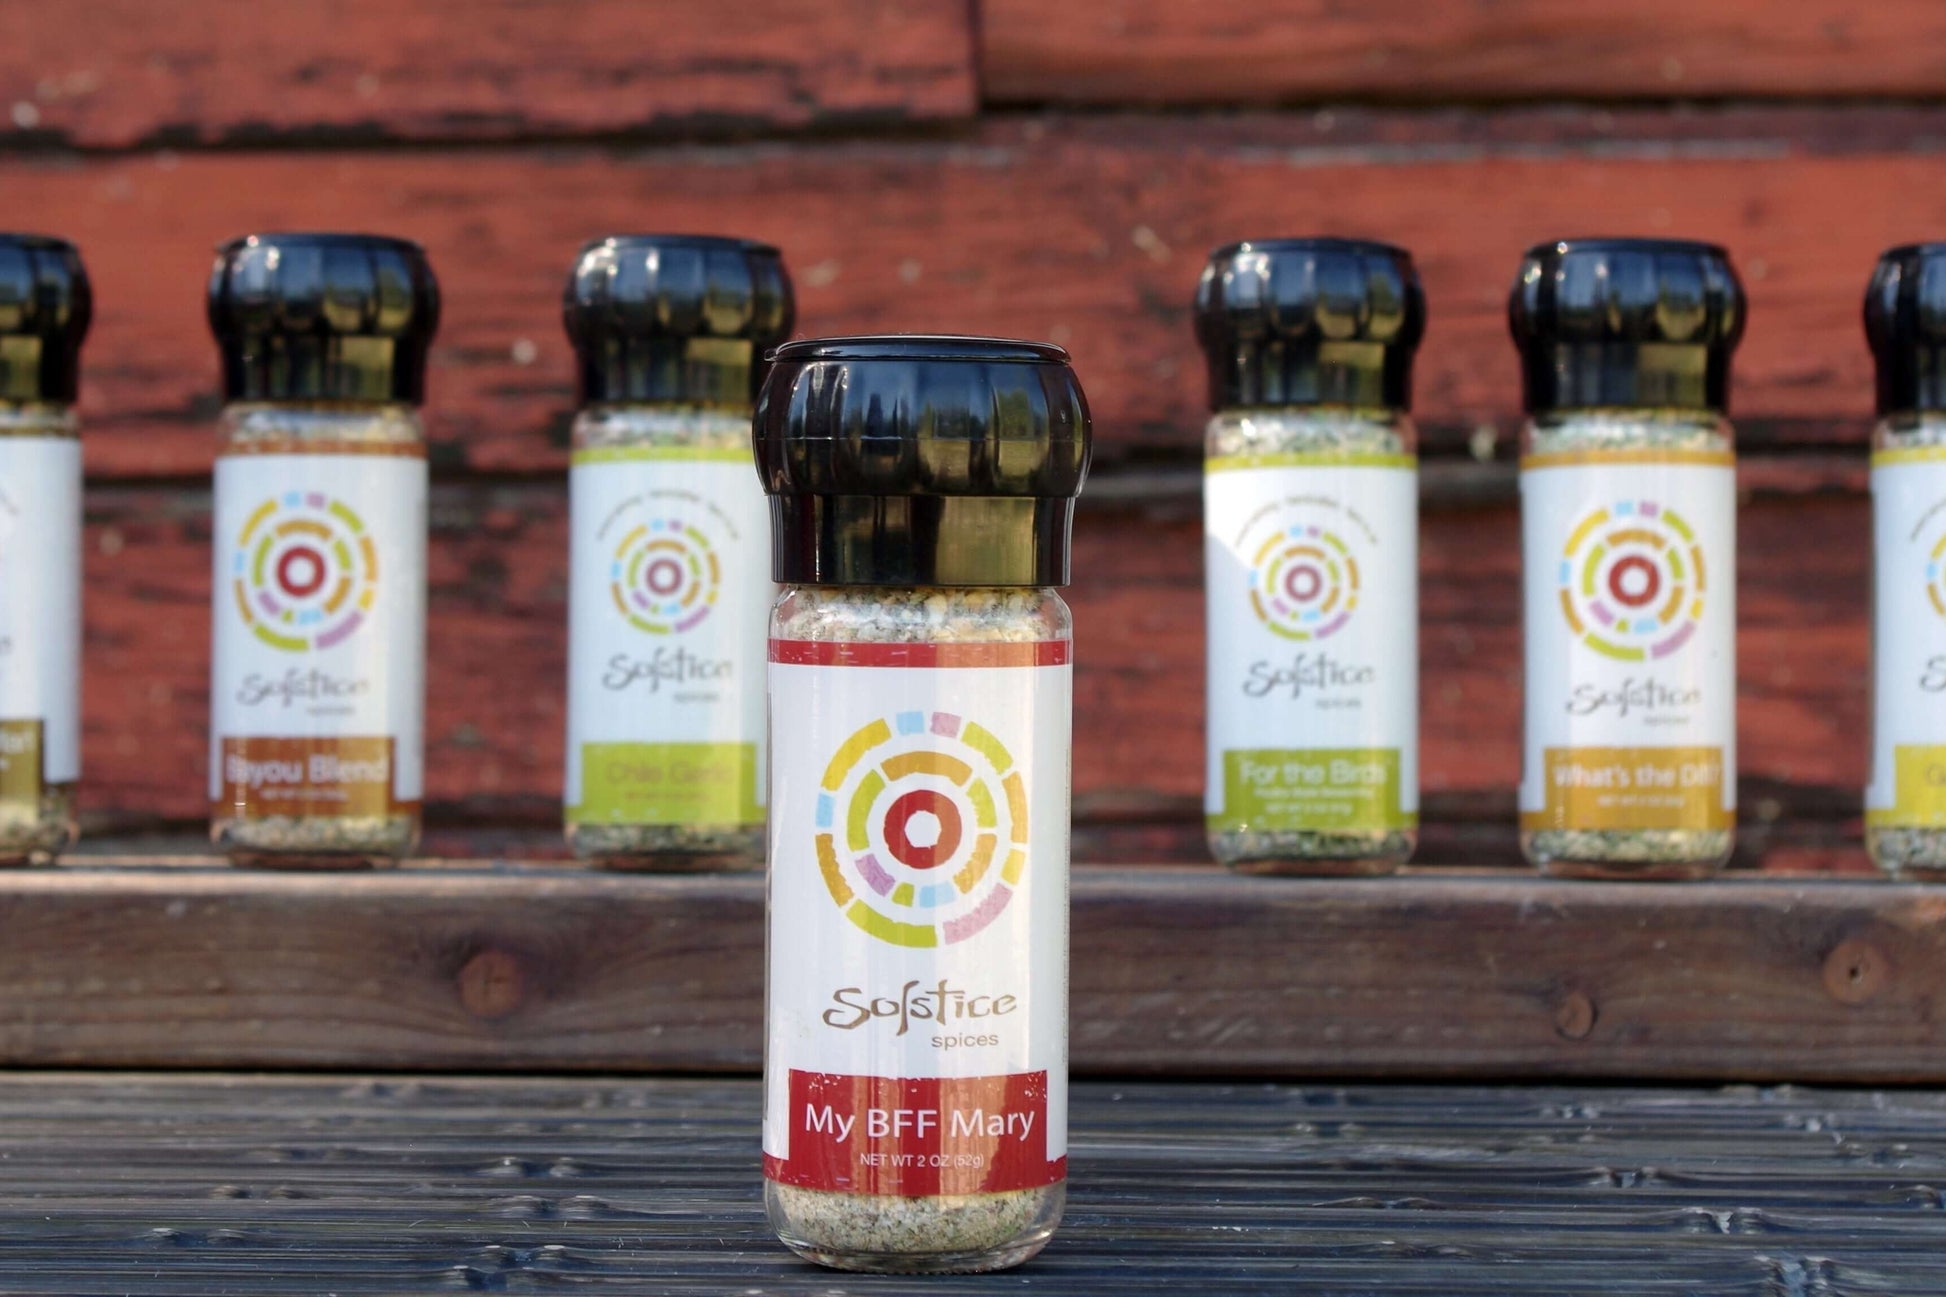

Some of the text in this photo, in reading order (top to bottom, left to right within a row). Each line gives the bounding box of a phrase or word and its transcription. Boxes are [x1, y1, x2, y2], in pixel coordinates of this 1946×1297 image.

[309, 754, 389, 783] Blend
[1240, 760, 1277, 786] For
[1283, 762, 1325, 785] the
[1555, 763, 1631, 788] What's
[1635, 763, 1676, 787] the
[822, 979, 1018, 1037] Solstice
[931, 1032, 999, 1051] spices
[805, 1103, 1036, 1143] My BFF Mary
[859, 1153, 985, 1169] NET WT 2 OZ (52g)
